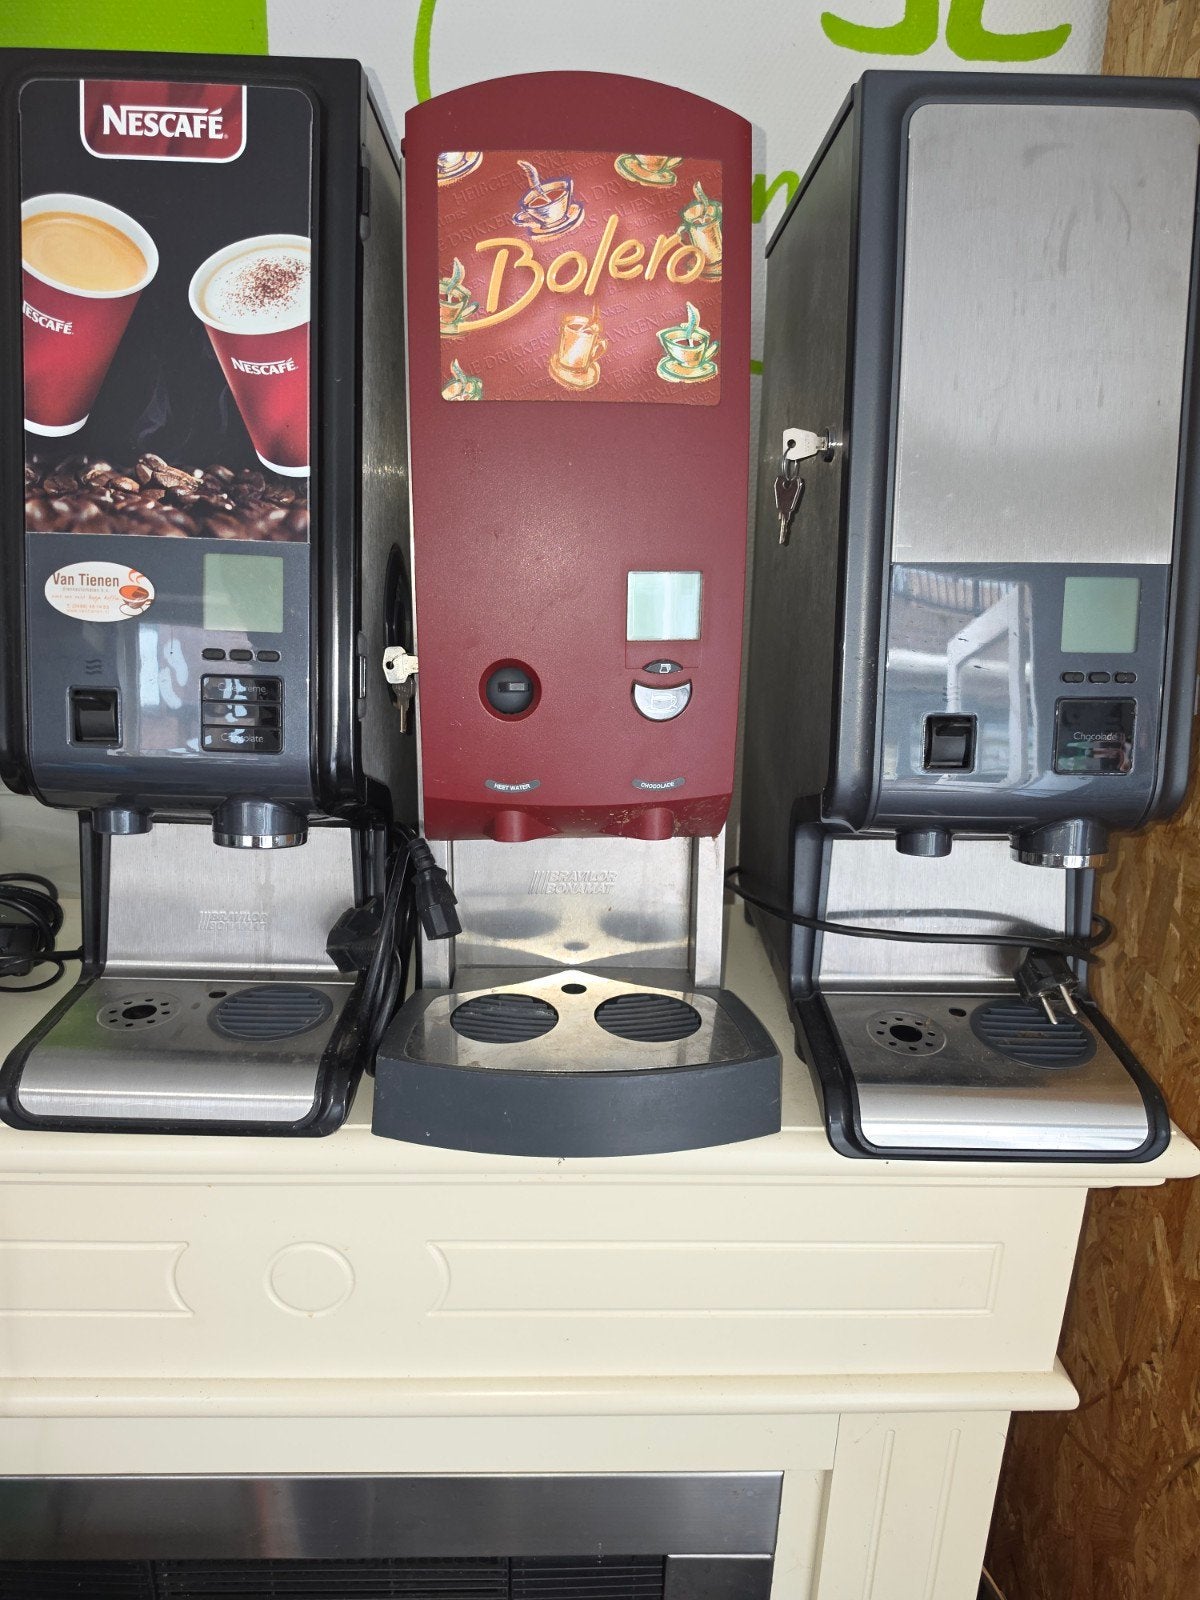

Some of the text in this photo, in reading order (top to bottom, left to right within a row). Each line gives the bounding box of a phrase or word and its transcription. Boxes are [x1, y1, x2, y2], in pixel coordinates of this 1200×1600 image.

[102, 104, 225, 140] NESCAFÉ
[457, 214, 706, 333] Bolero
[231, 357, 297, 376] NESCAFÉ
[53, 572, 119, 587] Van Tienen
[220, 732, 264, 743] Colate
[509, 783, 531, 791] WATER
